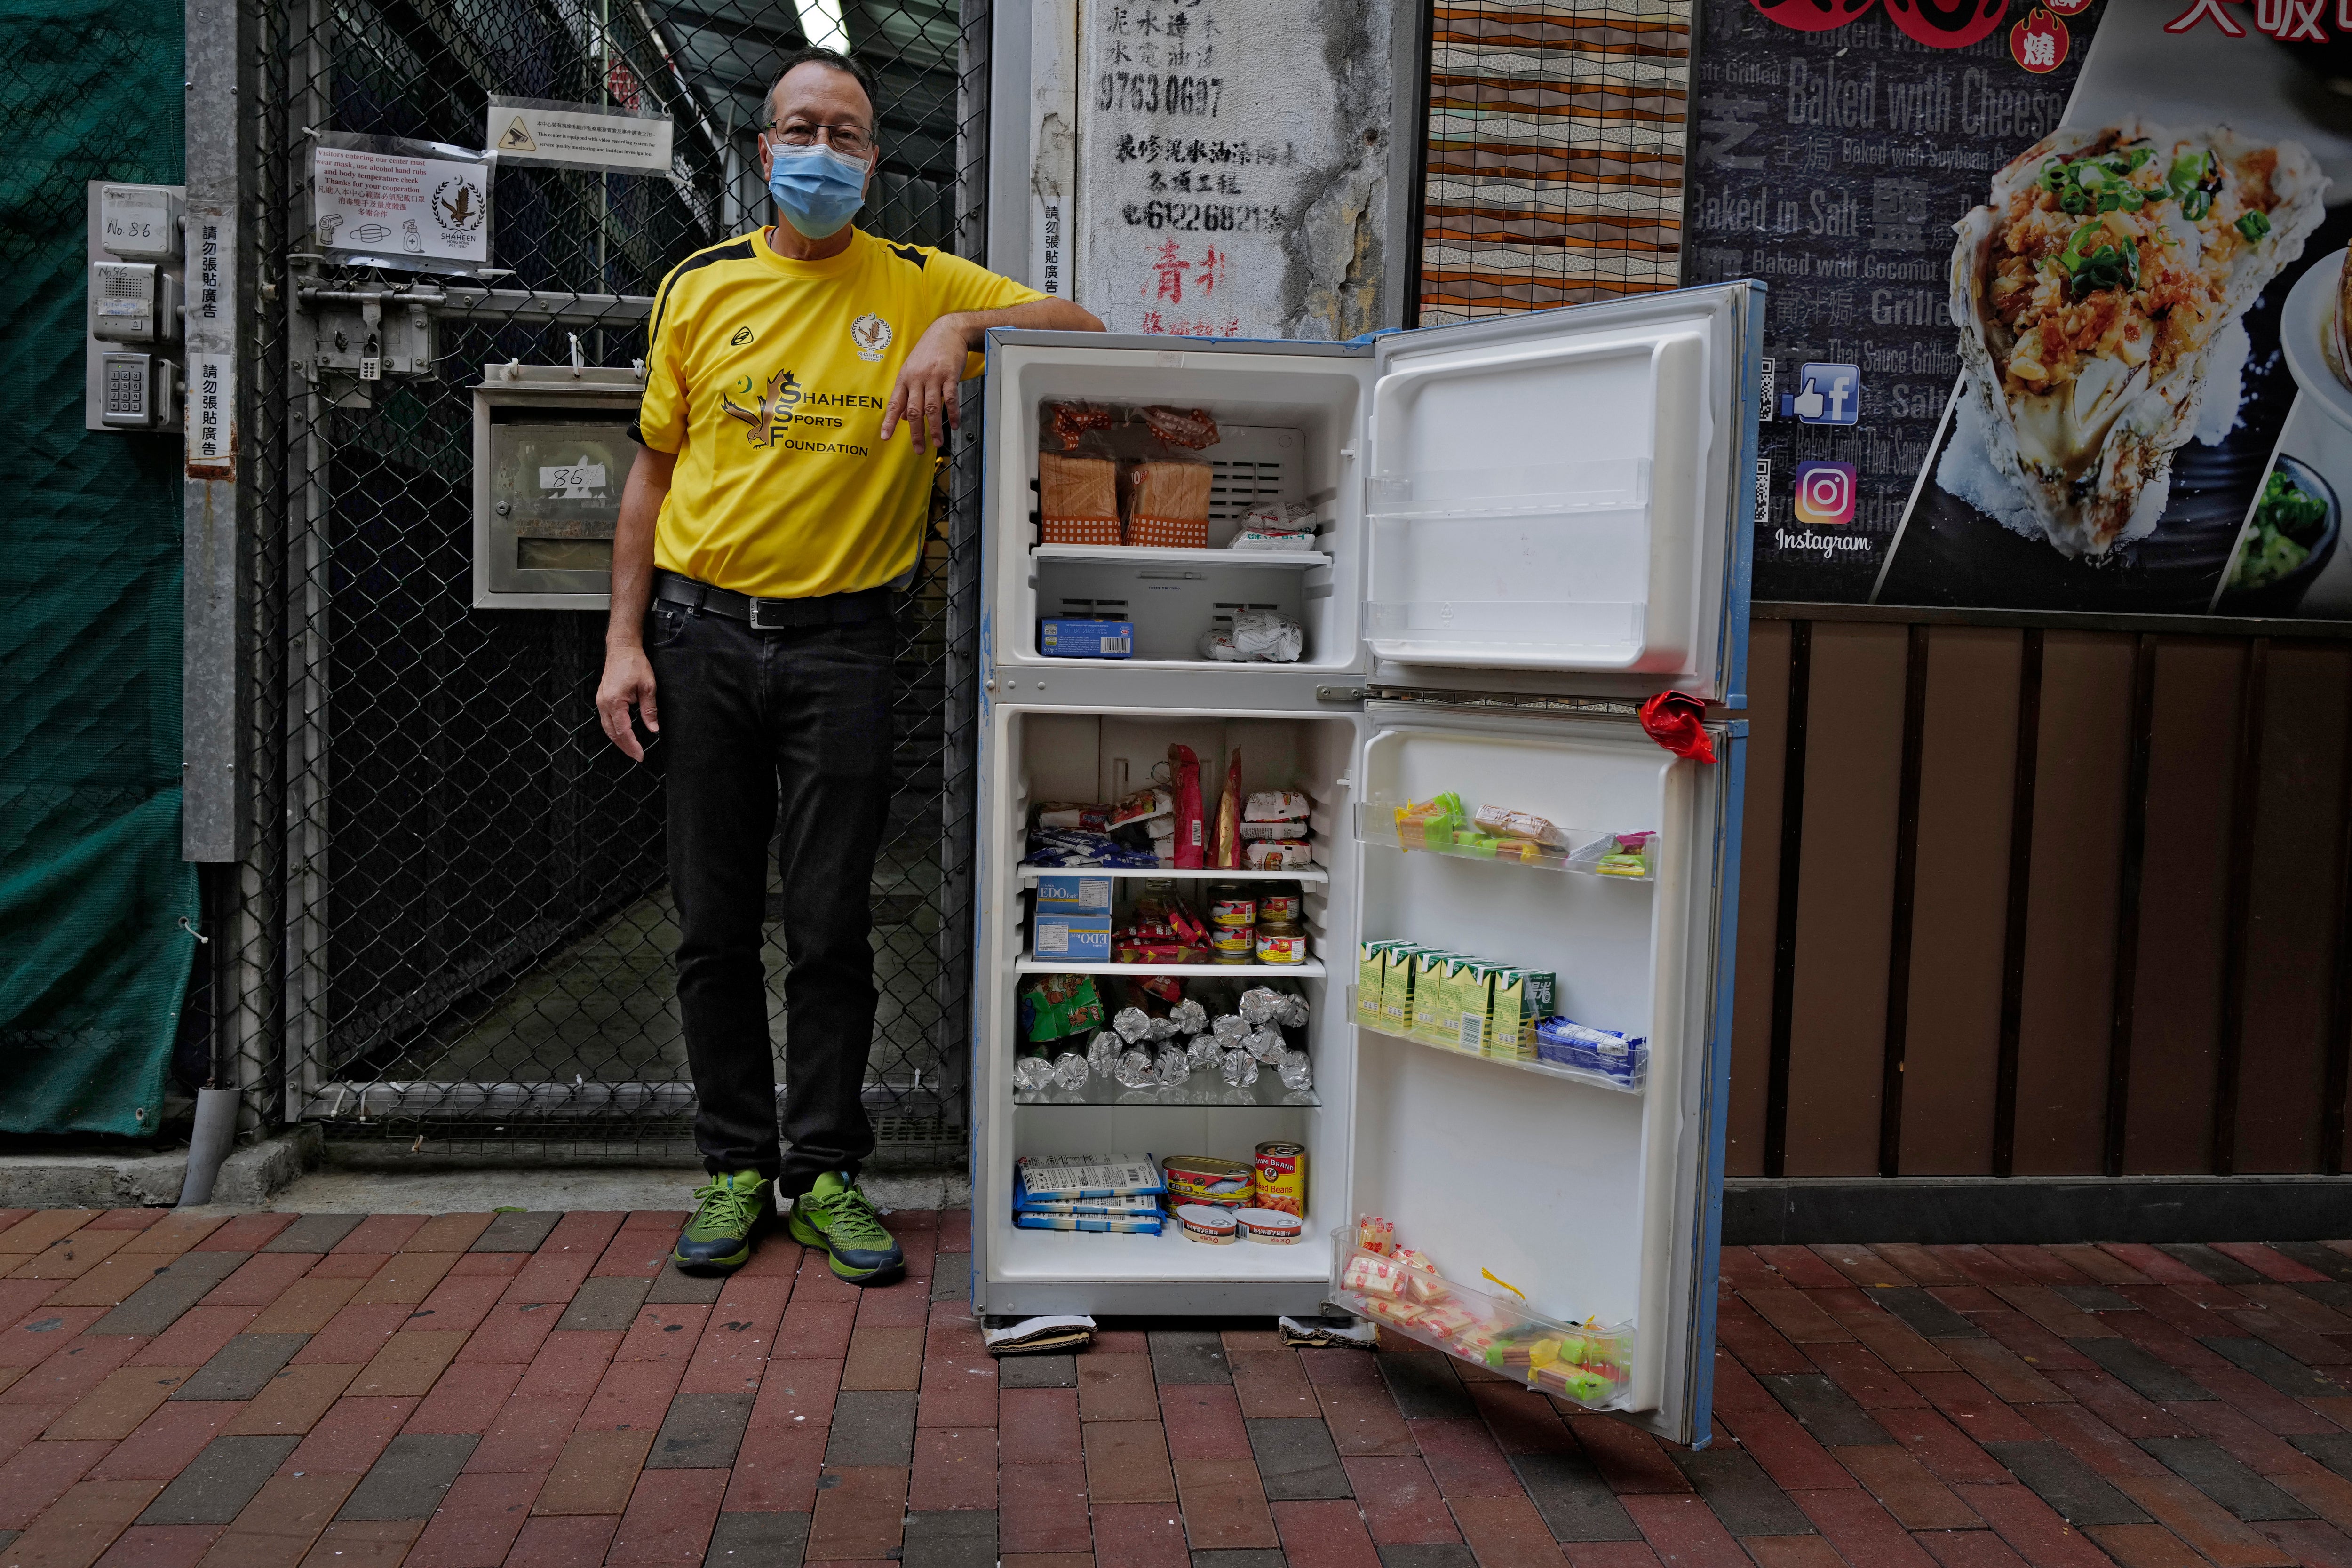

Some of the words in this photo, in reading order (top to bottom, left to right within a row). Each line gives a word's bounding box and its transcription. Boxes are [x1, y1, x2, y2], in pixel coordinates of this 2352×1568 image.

[2024, 32, 2055, 66] 燒
[1726, 62, 1781, 85] Grilled
[1788, 56, 1877, 128] Baked
[1888, 66, 1951, 133] with
[1962, 67, 2063, 138] Cheese
[345, 153, 374, 162] entering
[1843, 138, 1887, 165] Baked
[1891, 142, 1923, 166] with
[1929, 143, 1990, 174] Soybean
[325, 177, 350, 186] Thanks
[339, 170, 356, 178] body
[358, 173, 399, 182] temperature
[318, 185, 425, 203] 凡進入本中心範圍必須配戴口罩
[338, 197, 406, 210] 消毒雙手及量度體溫
[358, 208, 388, 218] 多謝合作
[1693, 183, 1767, 231] Baked
[1777, 188, 1799, 233] in
[1809, 189, 1859, 237] Salt
[129, 222, 150, 237] 86
[1045, 206, 1058, 293] 請勿張貼廣告
[202, 225, 217, 318] 請勿張貼廣告
[1753, 249, 1810, 276] Baked
[1817, 254, 1857, 278] with
[1865, 255, 1938, 282] Coconut
[1828, 338, 1858, 365] Thai
[1863, 340, 1907, 374] Sauce
[1913, 342, 1958, 375] Grilled
[779, 381, 883, 409] SHAHEEN
[1891, 383, 1947, 419] Salt
[202, 364, 217, 456] 請勿張貼廣告
[773, 405, 842, 428] SPORTS
[770, 426, 868, 457] FOUNDATION
[1866, 426, 1891, 474] Thai
[1893, 426, 1929, 476] Sauce
[553, 469, 584, 487] 86
[1775, 528, 1871, 559] Instagram
[1040, 887, 1067, 898] EDO
[1081, 933, 1107, 944] EDO
[1091, 1008, 1100, 1020] GINBIS
[1271, 1157, 1294, 1171] BRAND
[1271, 1184, 1293, 1193] Beans
